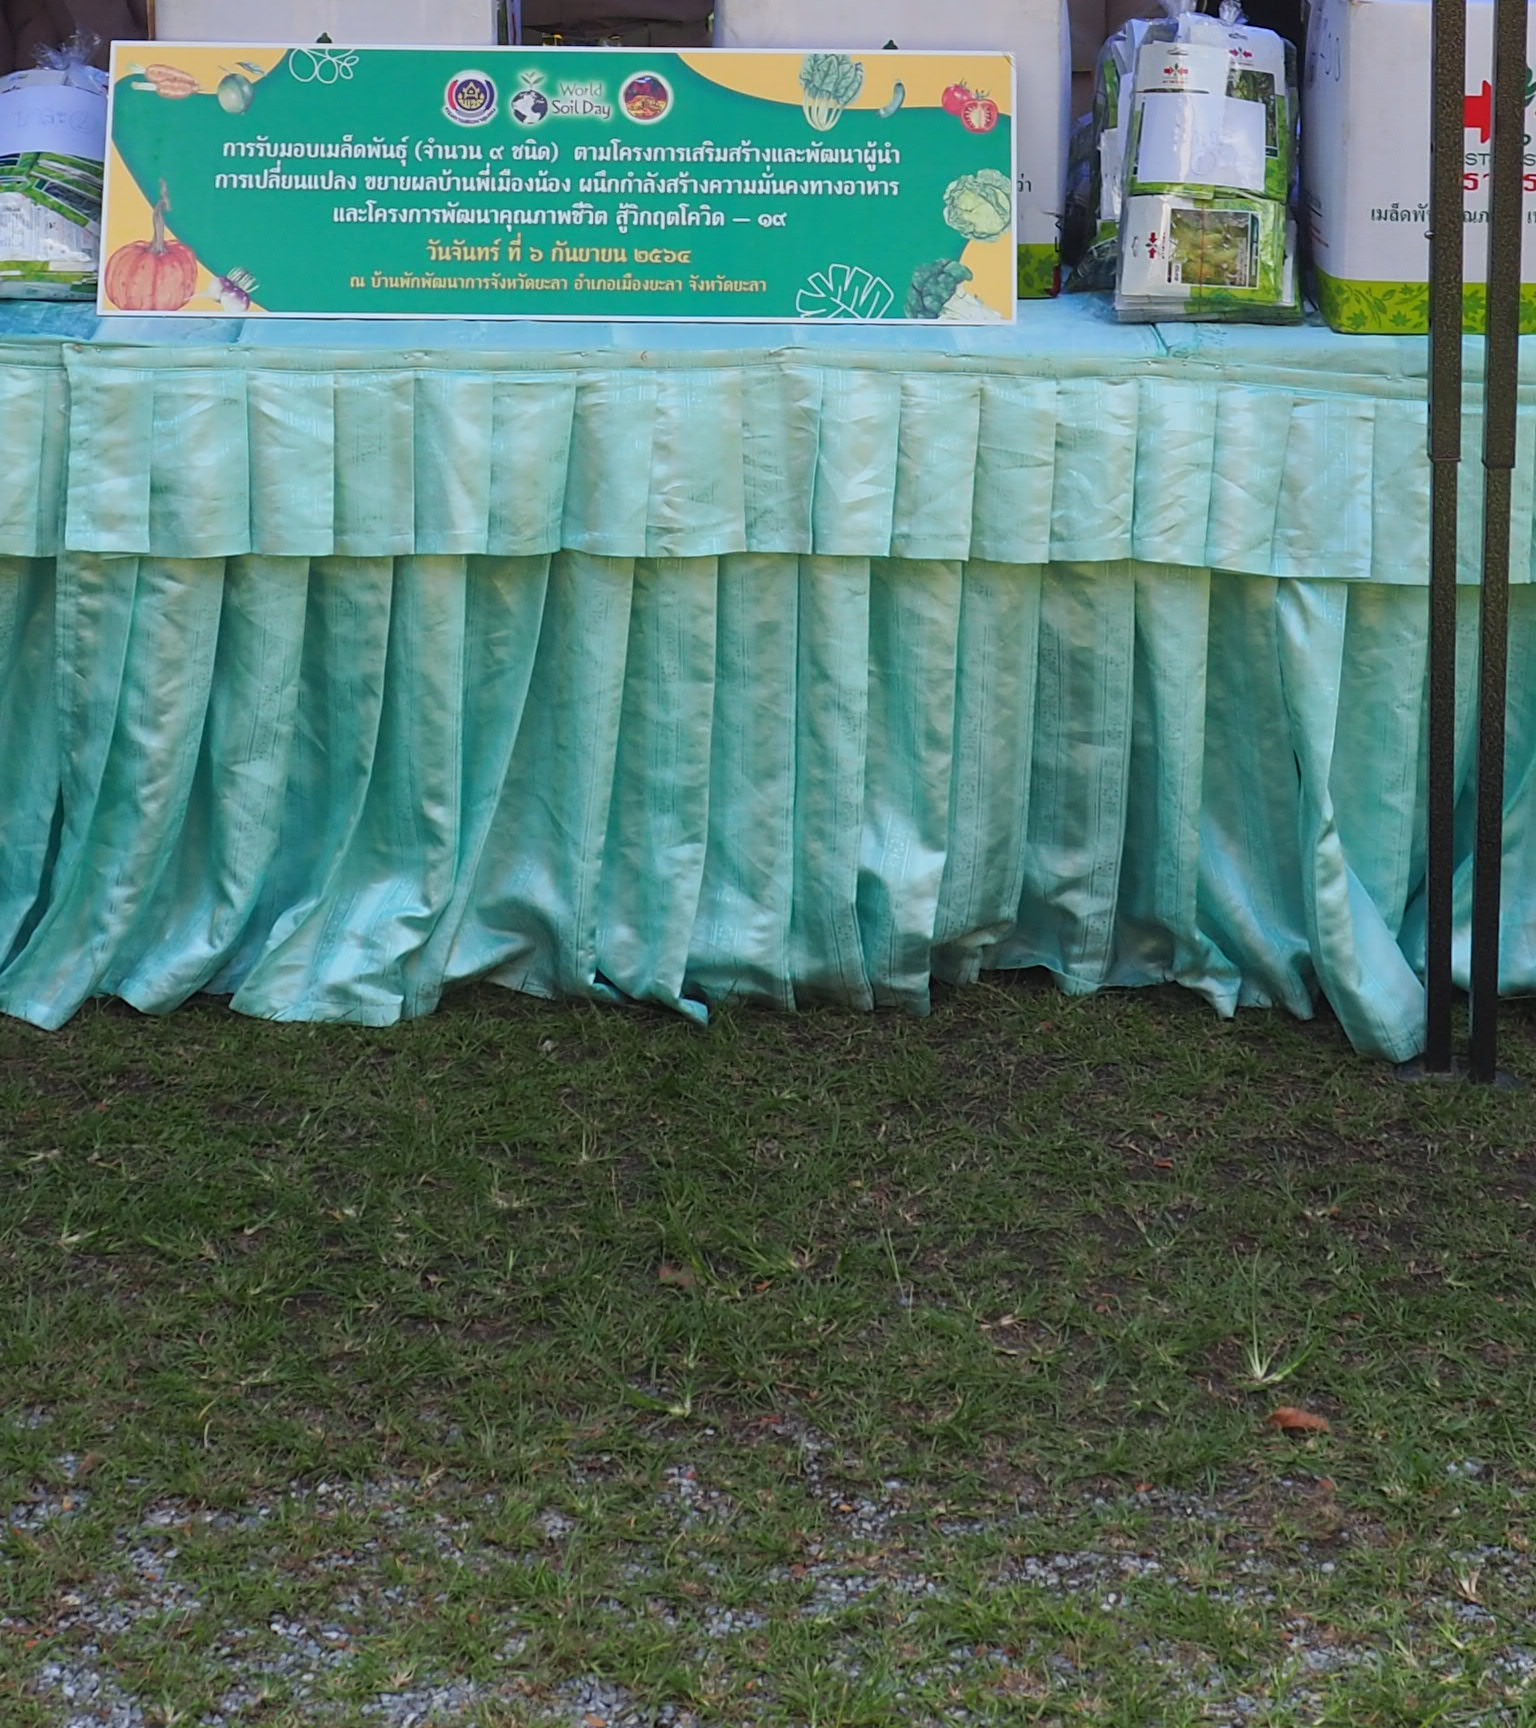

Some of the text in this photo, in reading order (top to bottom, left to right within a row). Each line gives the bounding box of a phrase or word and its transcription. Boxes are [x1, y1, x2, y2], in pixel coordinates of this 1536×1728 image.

[560, 82, 602, 96] World
[551, 100, 610, 119] Soil Day
[223, 133, 900, 172] การรับมอบเมล็ดพันธุ์ (จำนวน ๙ ชนิด) ตามโครงการเสริมสร้างและพัฒนาผู้นำ
[215, 160, 899, 195] การเปลี่ยนแปลง ขยายผลบ้านพี่เมืองน้อง ผนึกกำลังสร้างความมั่นคงทางอาหาร
[333, 200, 608, 232] และโครงการพัฒนาคุณภาพชีวิต
[616, 202, 725, 233] สู้วิกฤตโควิด
[758, 210, 787, 227] ๑๙
[426, 232, 692, 263] วันจันทร์ ที่ ๖ กันยายน ๒๕๖๔
[350, 270, 767, 292] ณ บ้านพักพัฒนาการจังหวัดยะลา อำเภอเมืองยะลา จังหวัดยะลา
